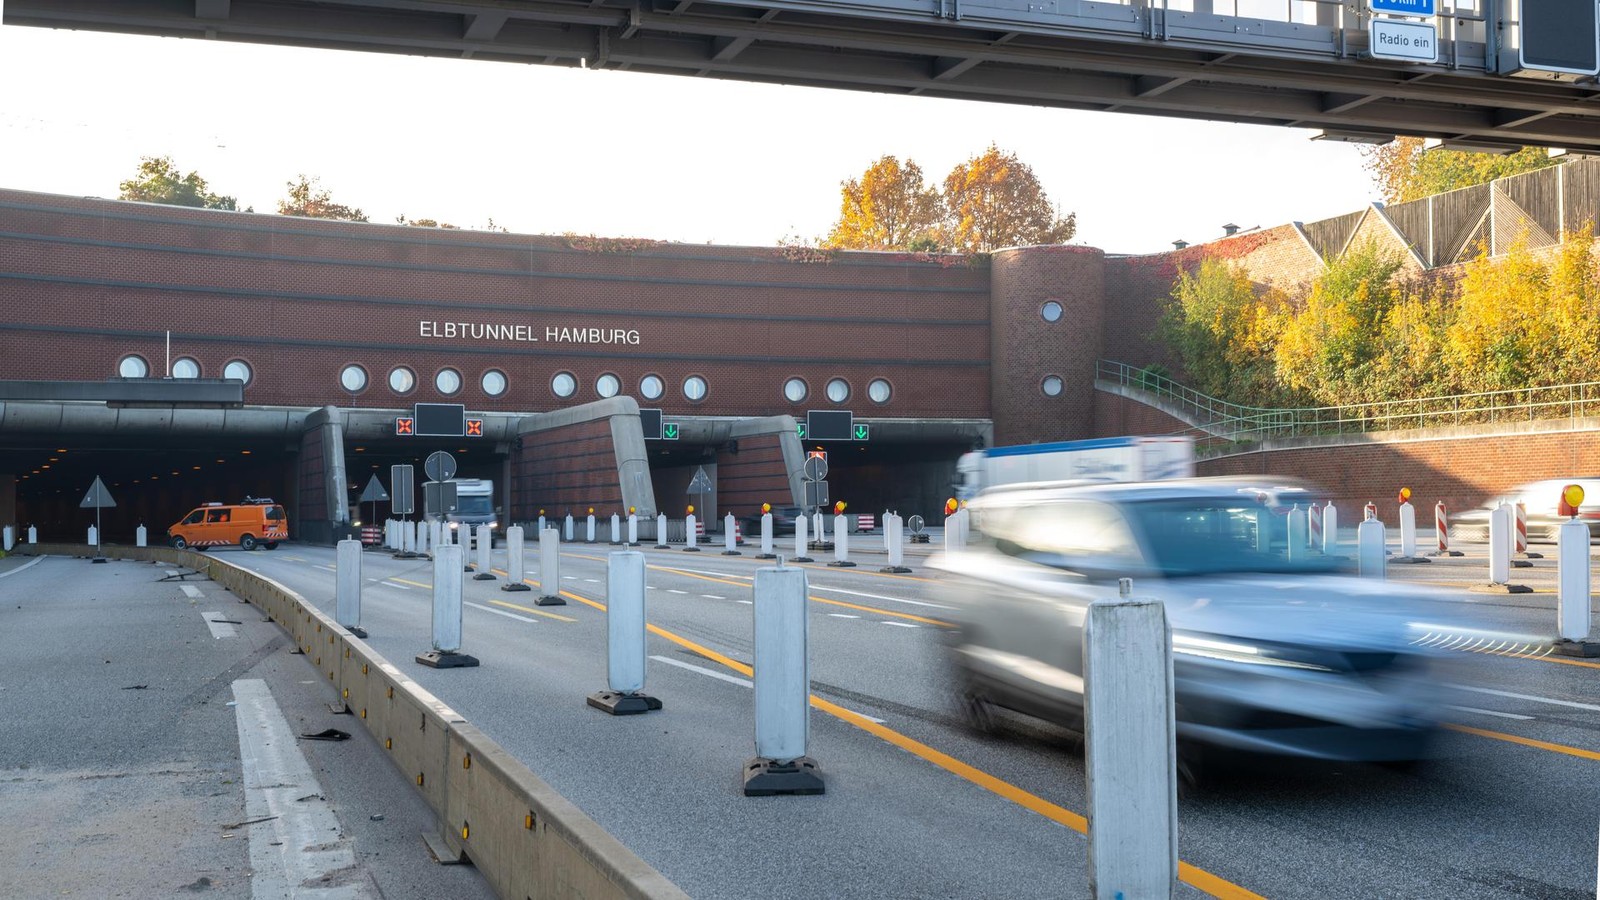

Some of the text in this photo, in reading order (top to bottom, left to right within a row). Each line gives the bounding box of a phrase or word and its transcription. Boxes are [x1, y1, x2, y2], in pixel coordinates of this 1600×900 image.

[1380, 32, 1429, 48] Radio ein
[420, 321, 640, 345] ELBTUNNEL HAMBURG
